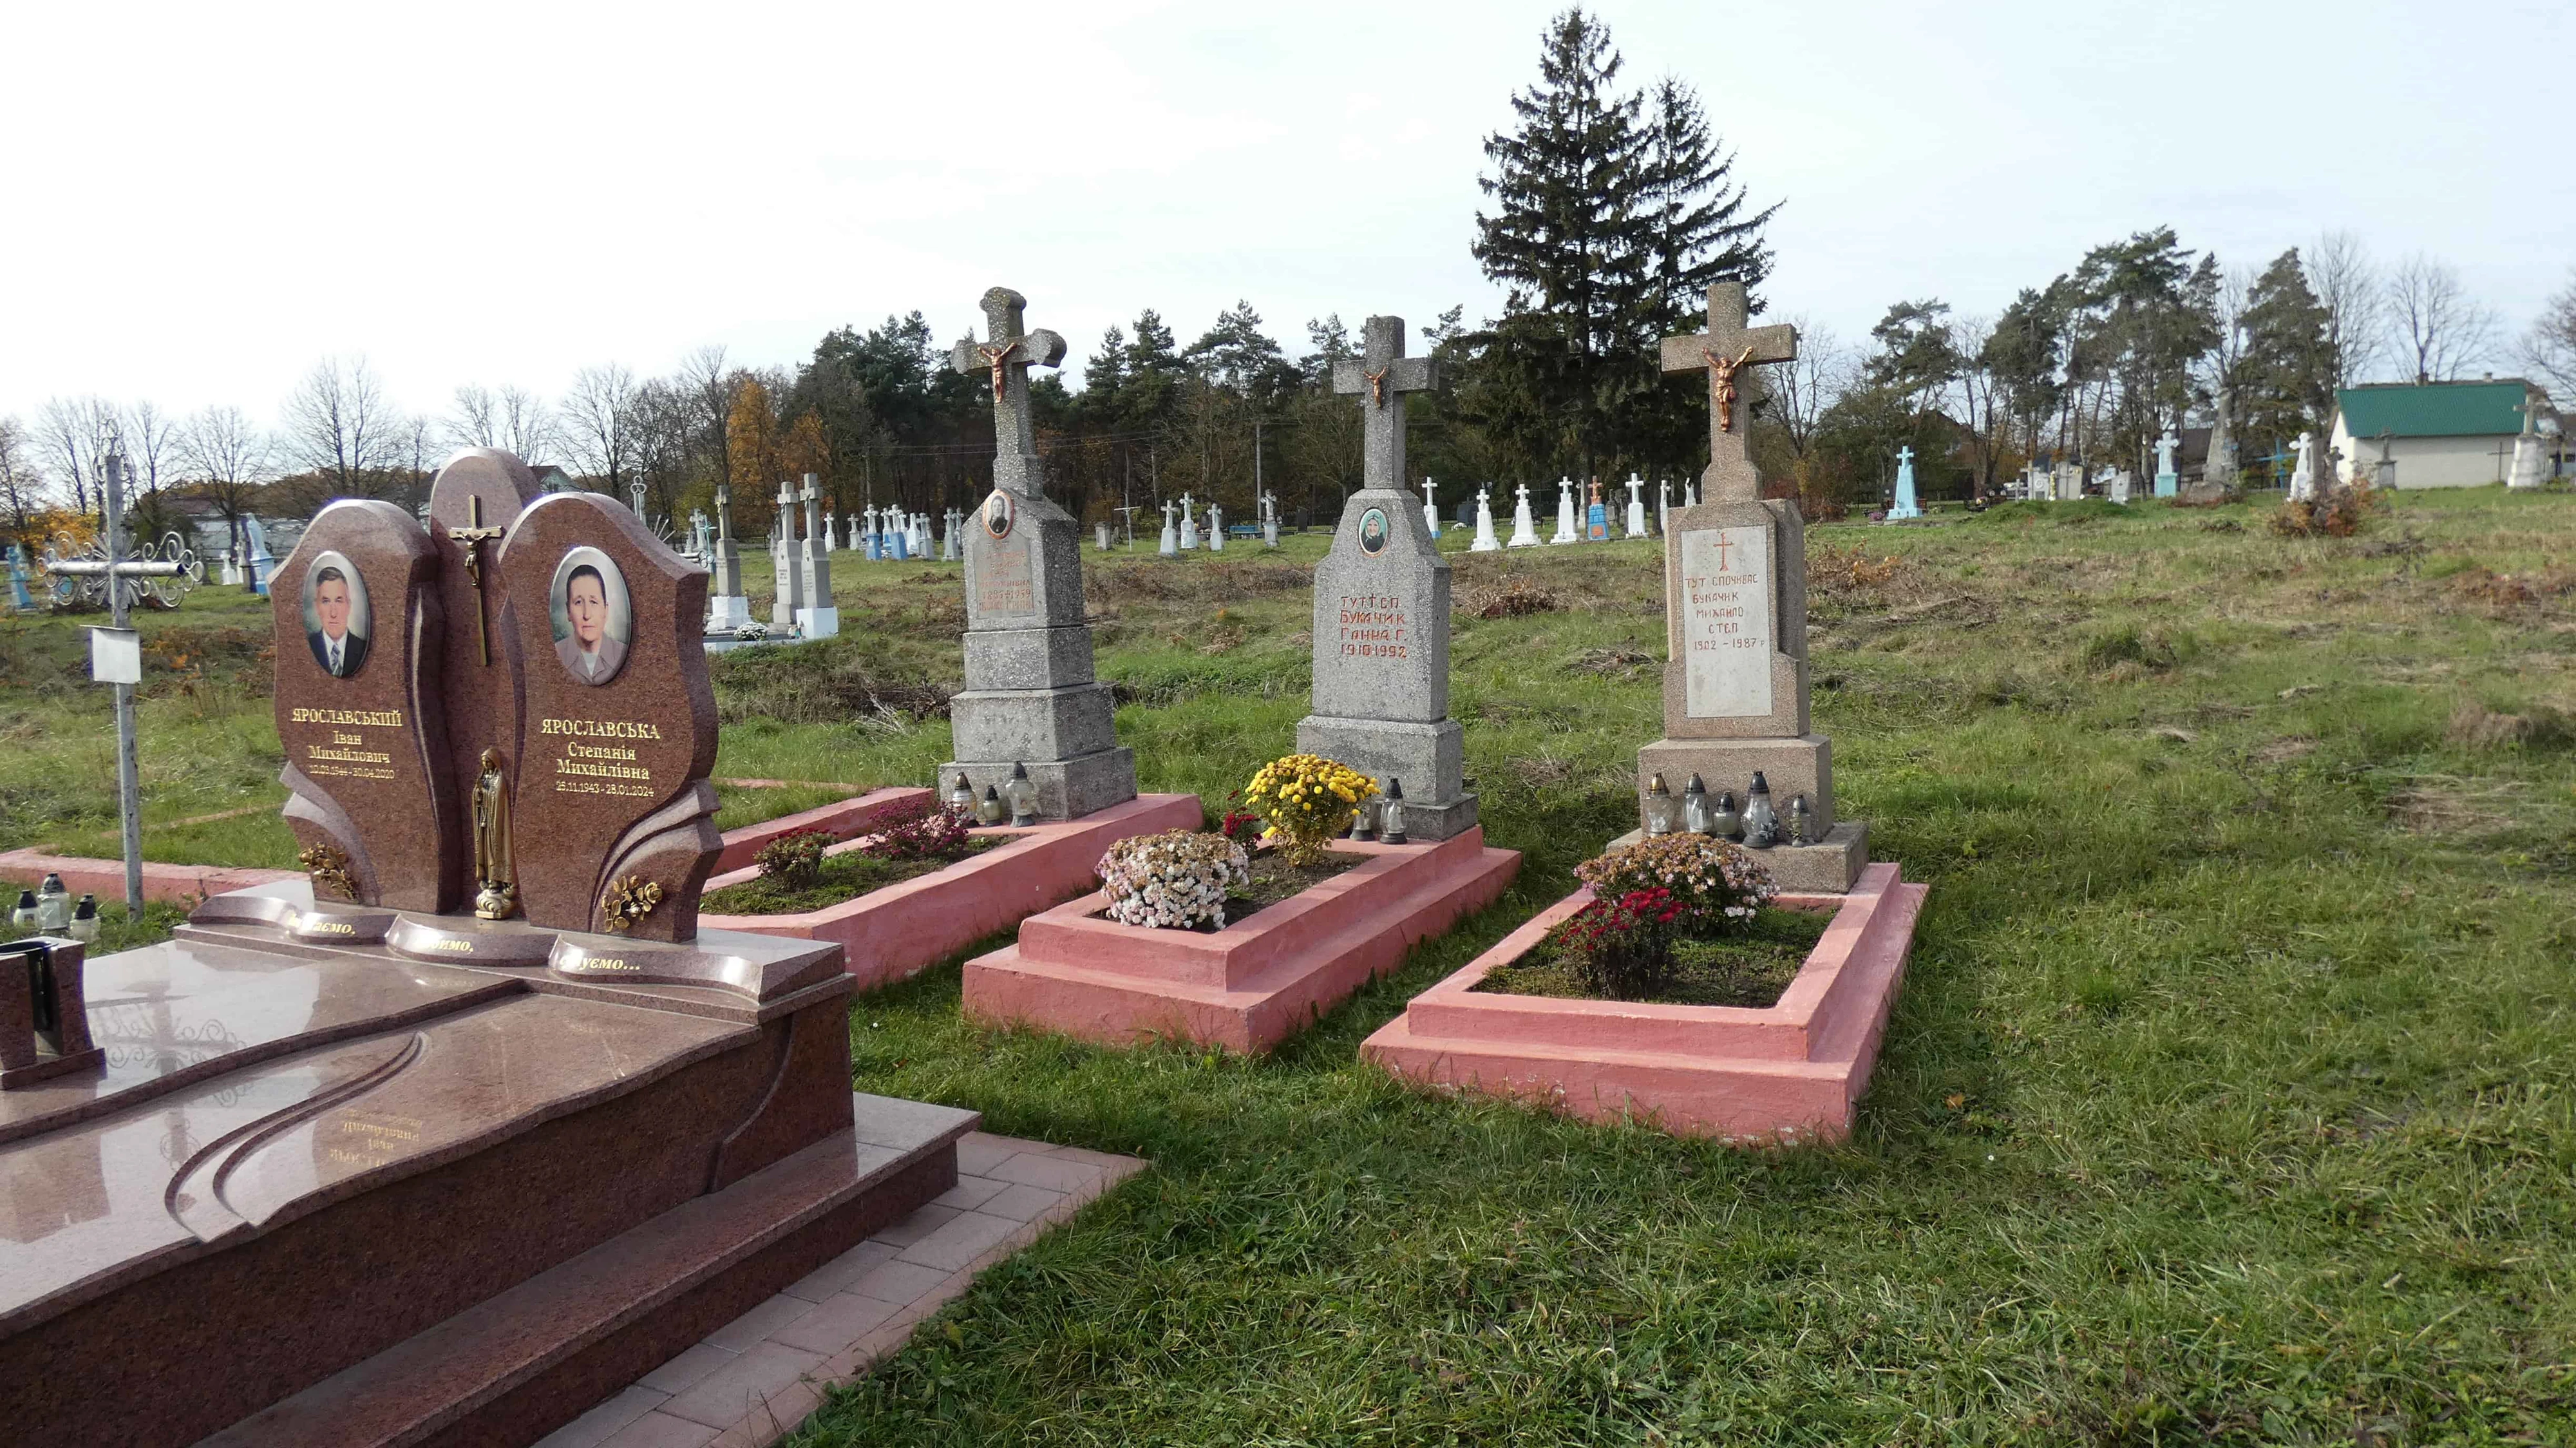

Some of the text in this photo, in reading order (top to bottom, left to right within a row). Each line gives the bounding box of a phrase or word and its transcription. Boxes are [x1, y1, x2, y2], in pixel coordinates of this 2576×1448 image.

[1685, 576, 1706, 588] ТУТ
[1341, 596, 1366, 607] ТУТ
[1692, 591, 1739, 604] БУКАЧИК
[1340, 609, 1406, 625] БУКАЧИК
[1341, 627, 1407, 642] ГАННА Г.
[1341, 643, 1407, 658] 1910 1992
[1694, 640, 1716, 651] 1902
[1732, 638, 1757, 649] 1987
[291, 708, 403, 727] ЯРОСЛАВСЬКИЙ
[541, 719, 661, 739] ЯРОСЛАВСЬКА
[332, 730, 363, 745] Іван
[308, 745, 391, 763] Михайлович
[567, 741, 637, 760] Степанія
[556, 758, 650, 780] Михайлівна
[606, 784, 654, 797] 28.01.2024
[559, 955, 641, 971] суємо...
